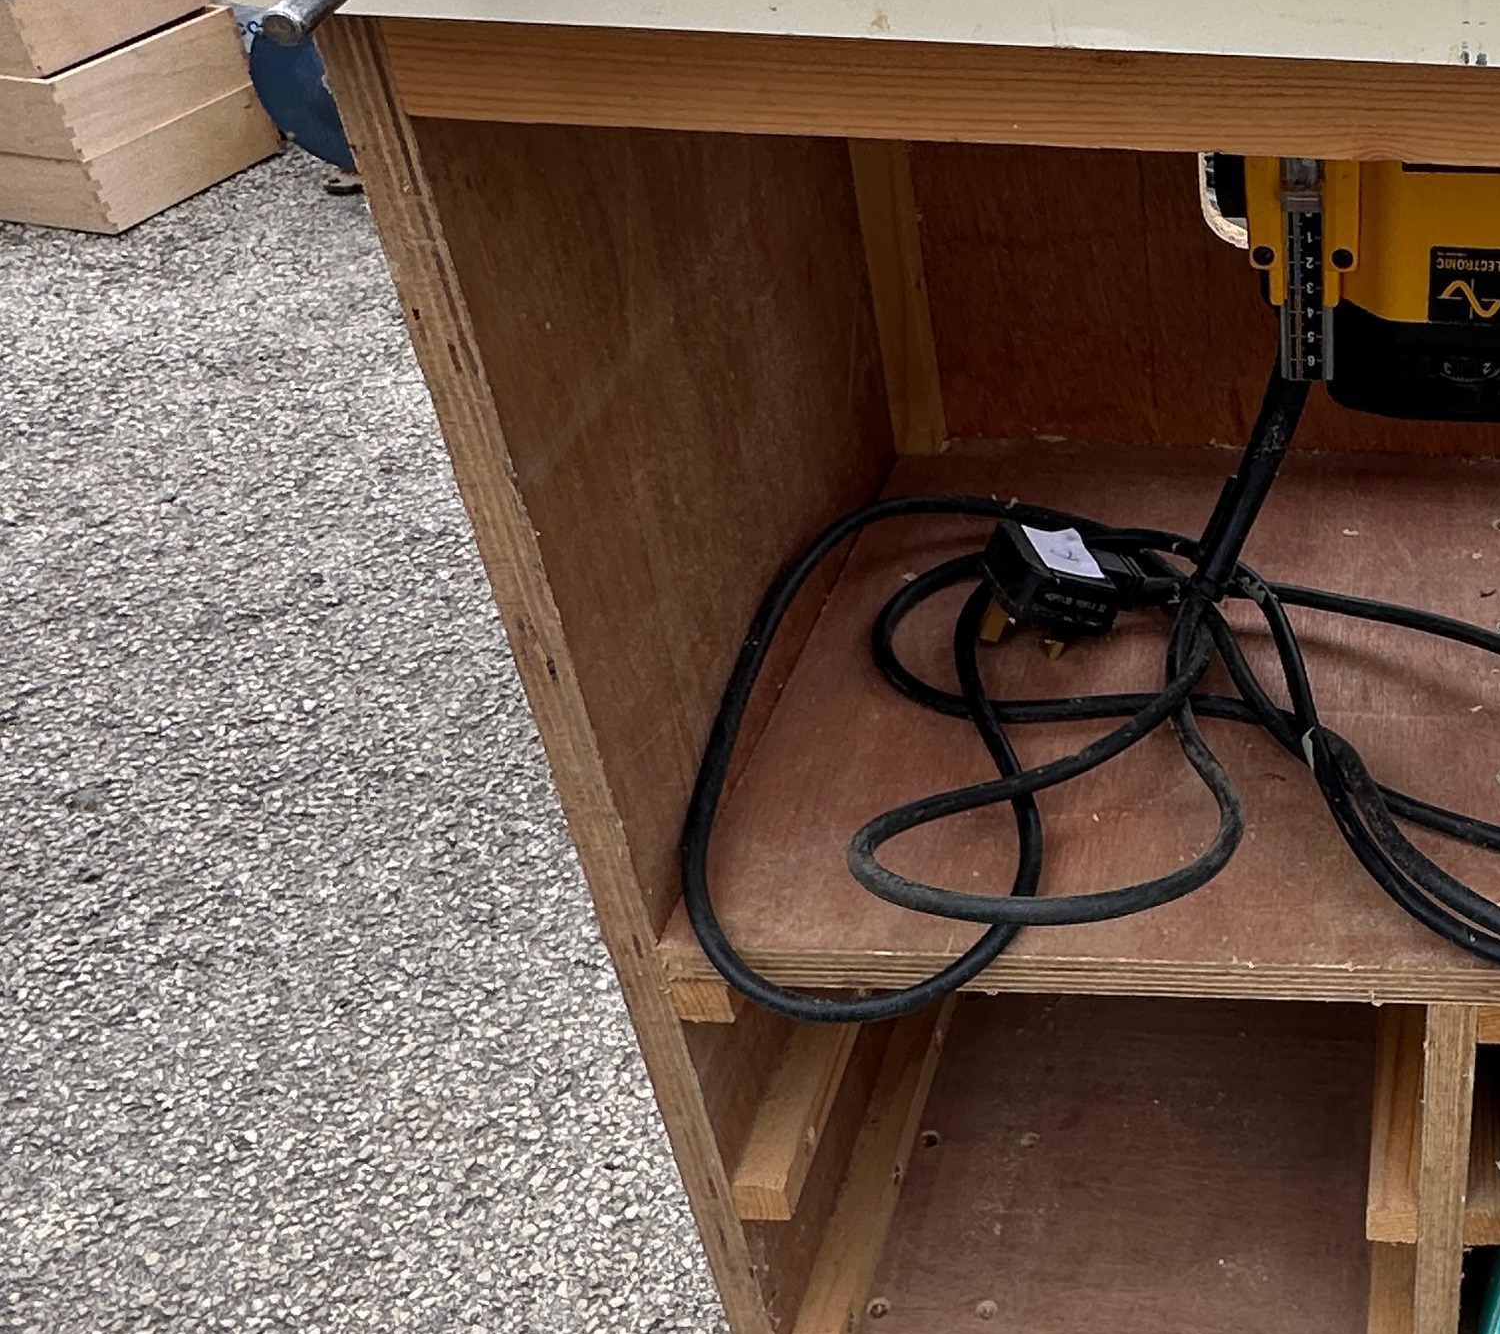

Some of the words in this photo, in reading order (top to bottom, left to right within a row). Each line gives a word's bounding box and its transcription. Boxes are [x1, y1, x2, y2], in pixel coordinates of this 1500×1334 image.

[1306, 231, 1313, 244] 1
[1305, 256, 1315, 269] 2
[1306, 281, 1315, 294] 3
[1306, 307, 1315, 319] 4
[1307, 331, 1316, 343] 5
